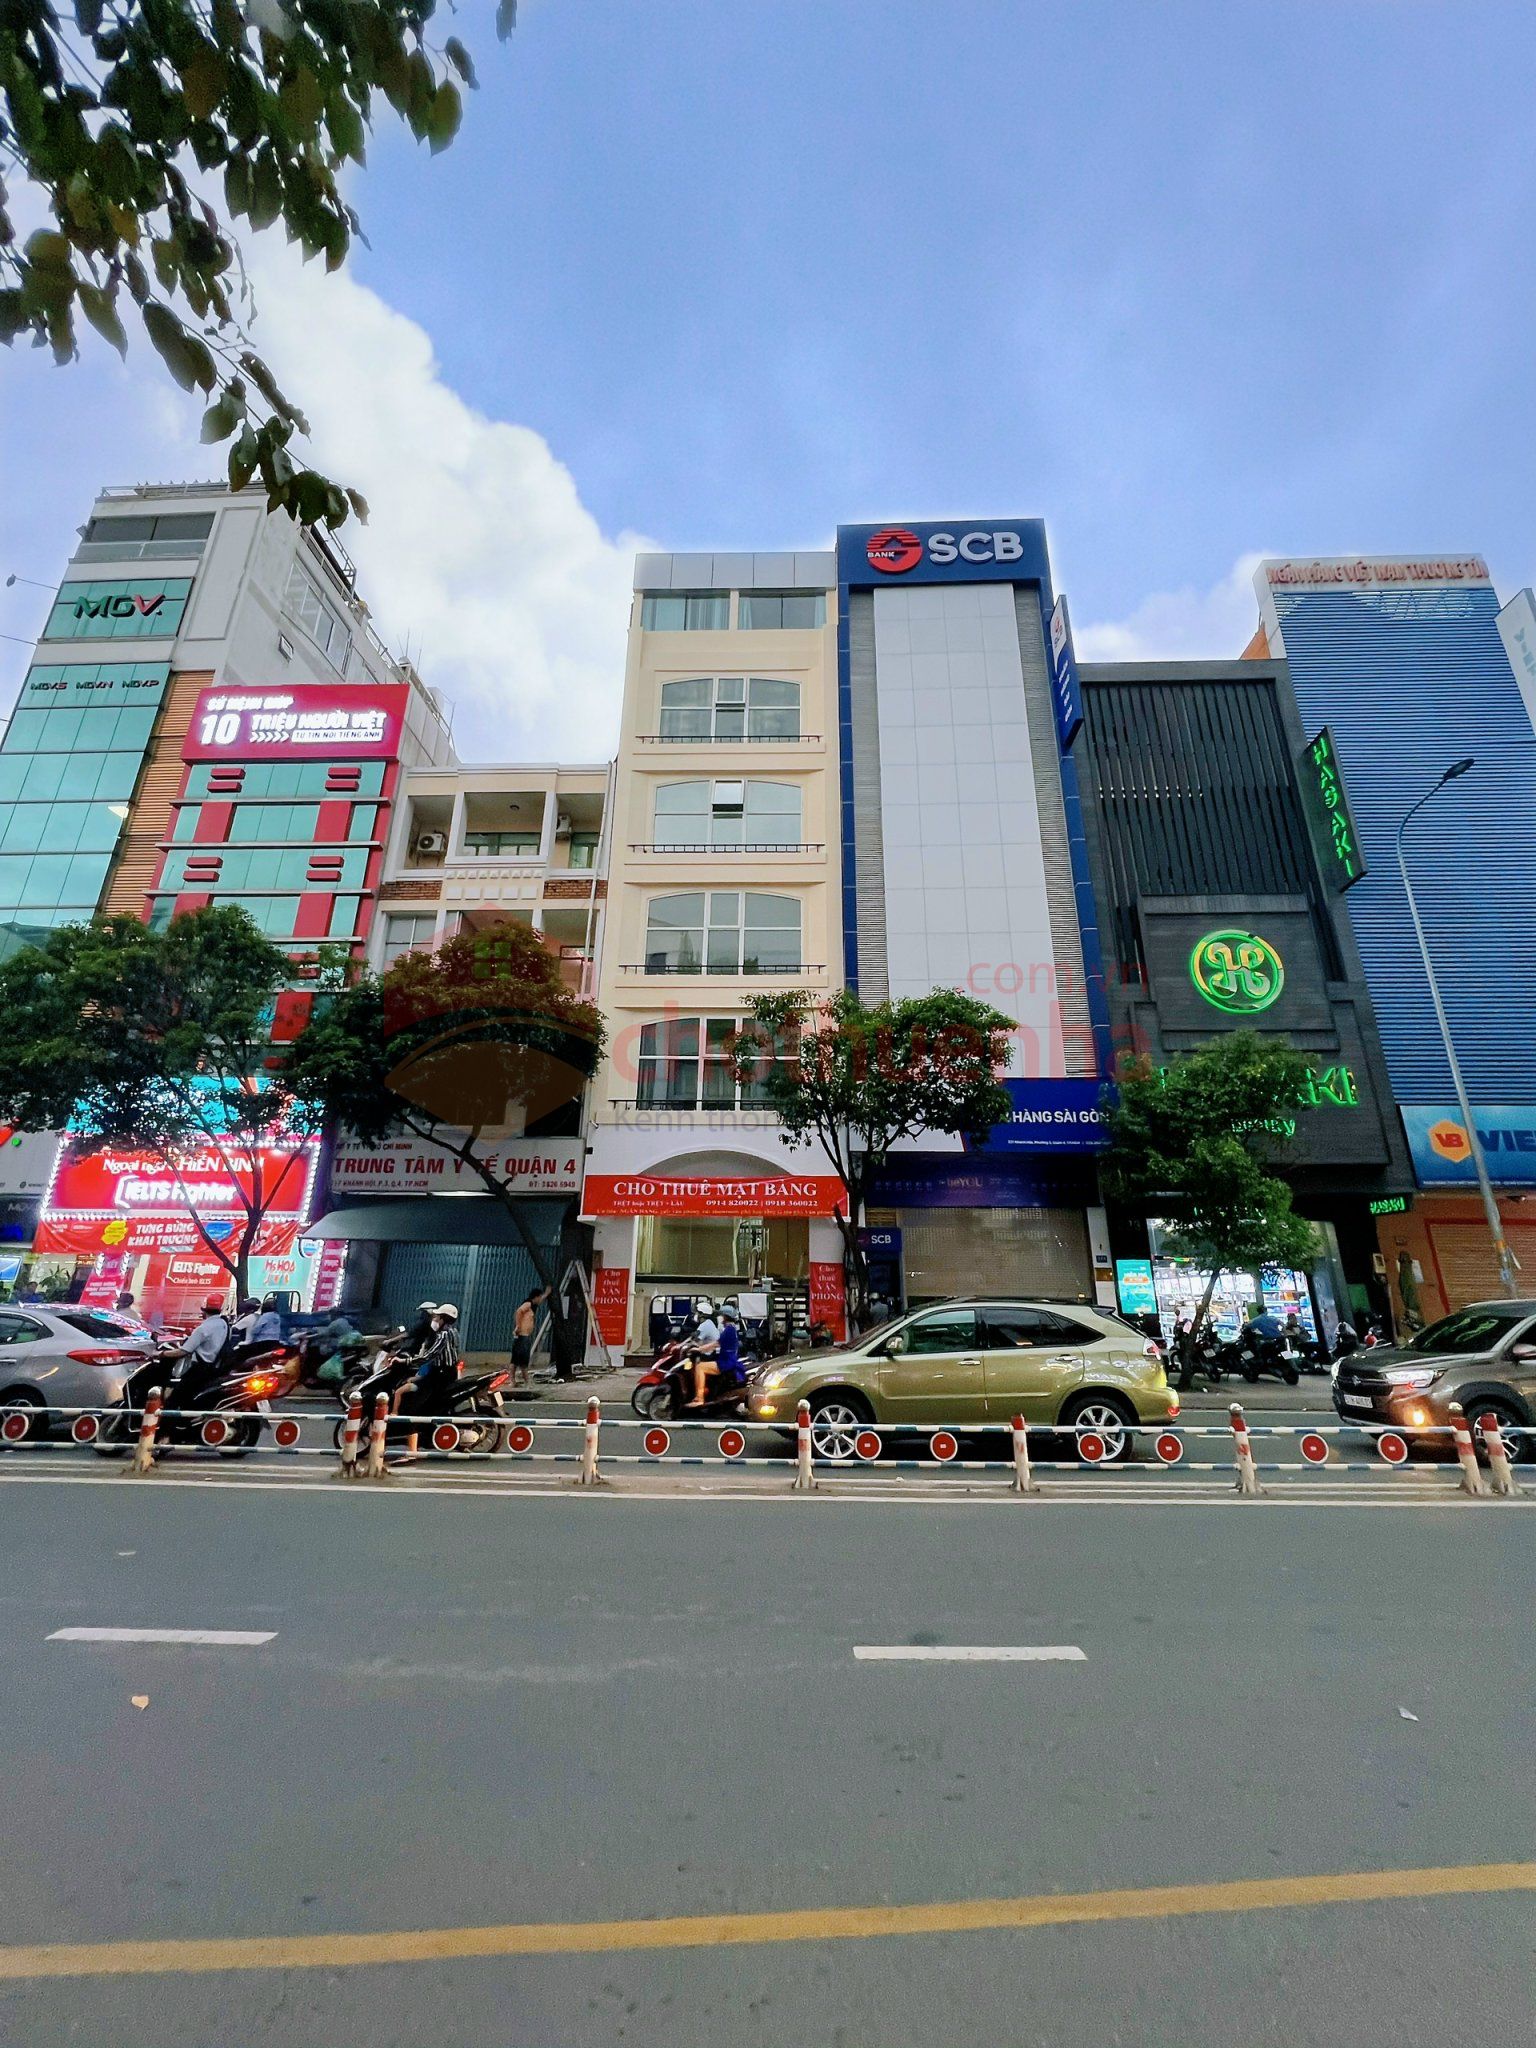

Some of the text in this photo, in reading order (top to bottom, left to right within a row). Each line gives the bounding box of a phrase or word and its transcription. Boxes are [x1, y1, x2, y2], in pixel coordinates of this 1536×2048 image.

[867, 551, 895, 559] BANK
[927, 531, 1024, 565] SCB
[201, 713, 241, 746] 10
[1012, 1108, 1052, 1123] HÀNG
[1054, 1108, 1077, 1123] SÀI
[103, 1158, 141, 1175] Ngoại
[335, 1158, 396, 1174] TRUNG
[404, 1155, 445, 1174] TÂM
[453, 1158, 464, 1174] Y
[505, 1155, 557, 1178] QUẬN
[563, 1158, 576, 1174] 4
[123, 1181, 172, 1202] IELTS
[613, 1182, 655, 1197] CHO
[660, 1179, 711, 1197] THUÊ
[127, 1235, 155, 1246] KHAI
[871, 1234, 892, 1244] SCB
[172, 1261, 193, 1273] IELTS
[605, 1269, 621, 1277] Cho
